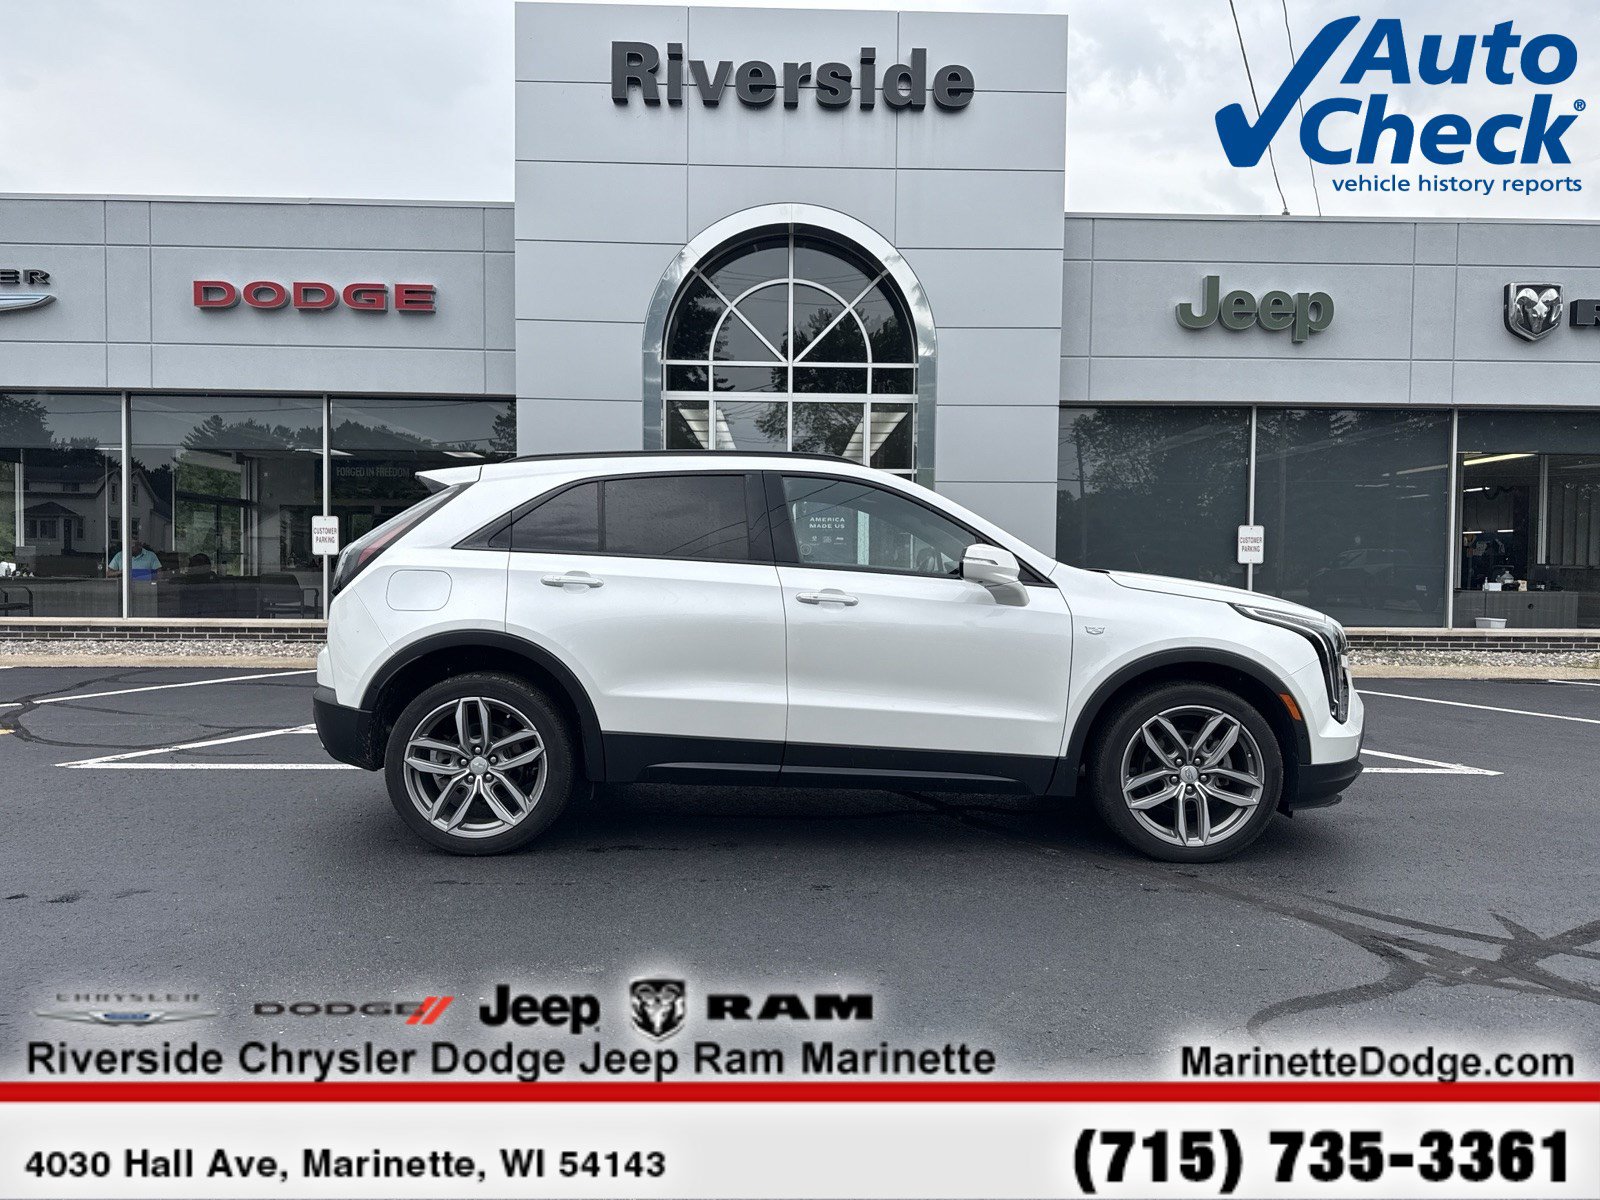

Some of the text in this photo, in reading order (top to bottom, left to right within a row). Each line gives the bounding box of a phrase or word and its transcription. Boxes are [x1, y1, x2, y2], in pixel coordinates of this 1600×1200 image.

[611, 41, 975, 111] Riverside
[193, 280, 436, 314] DODGE
[1175, 275, 1335, 343] Jeep
[336, 466, 365, 477] FORGED
[366, 466, 375, 477] IN
